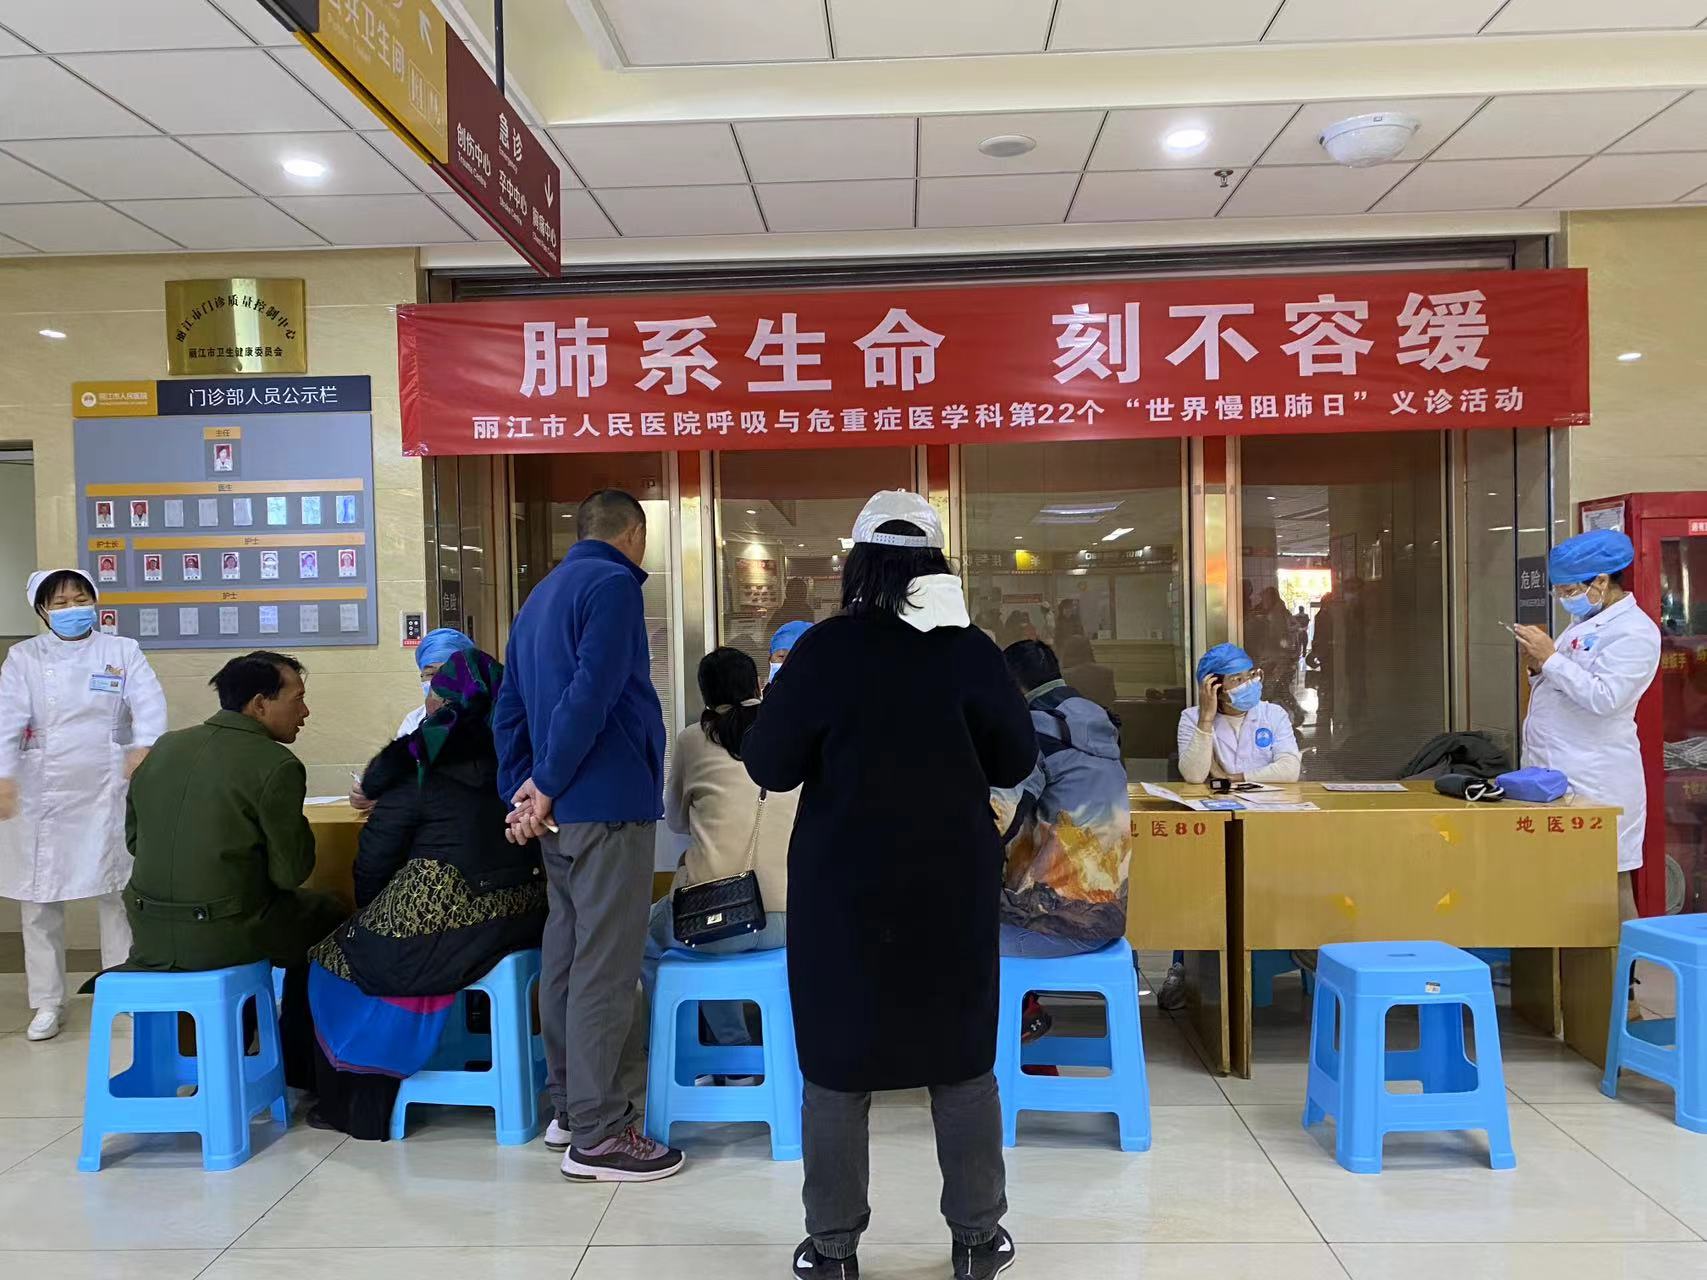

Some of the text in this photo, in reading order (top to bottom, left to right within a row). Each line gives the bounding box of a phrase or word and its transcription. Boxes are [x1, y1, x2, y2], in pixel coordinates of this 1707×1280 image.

[328, 0, 404, 82] 共卫生间
[456, 122, 491, 177] 创伤中心
[499, 112, 523, 162] 急诊
[499, 169, 528, 216] 卒中中心
[176, 294, 296, 342] 丽江市门诊质量控制中心
[188, 346, 283, 359] 丽江市卫生健康委员会
[520, 290, 1491, 400] 肺系生命 刻不容缓
[189, 385, 338, 407] 门诊部人员公示栏
[1516, 815, 1603, 833] 地医92
